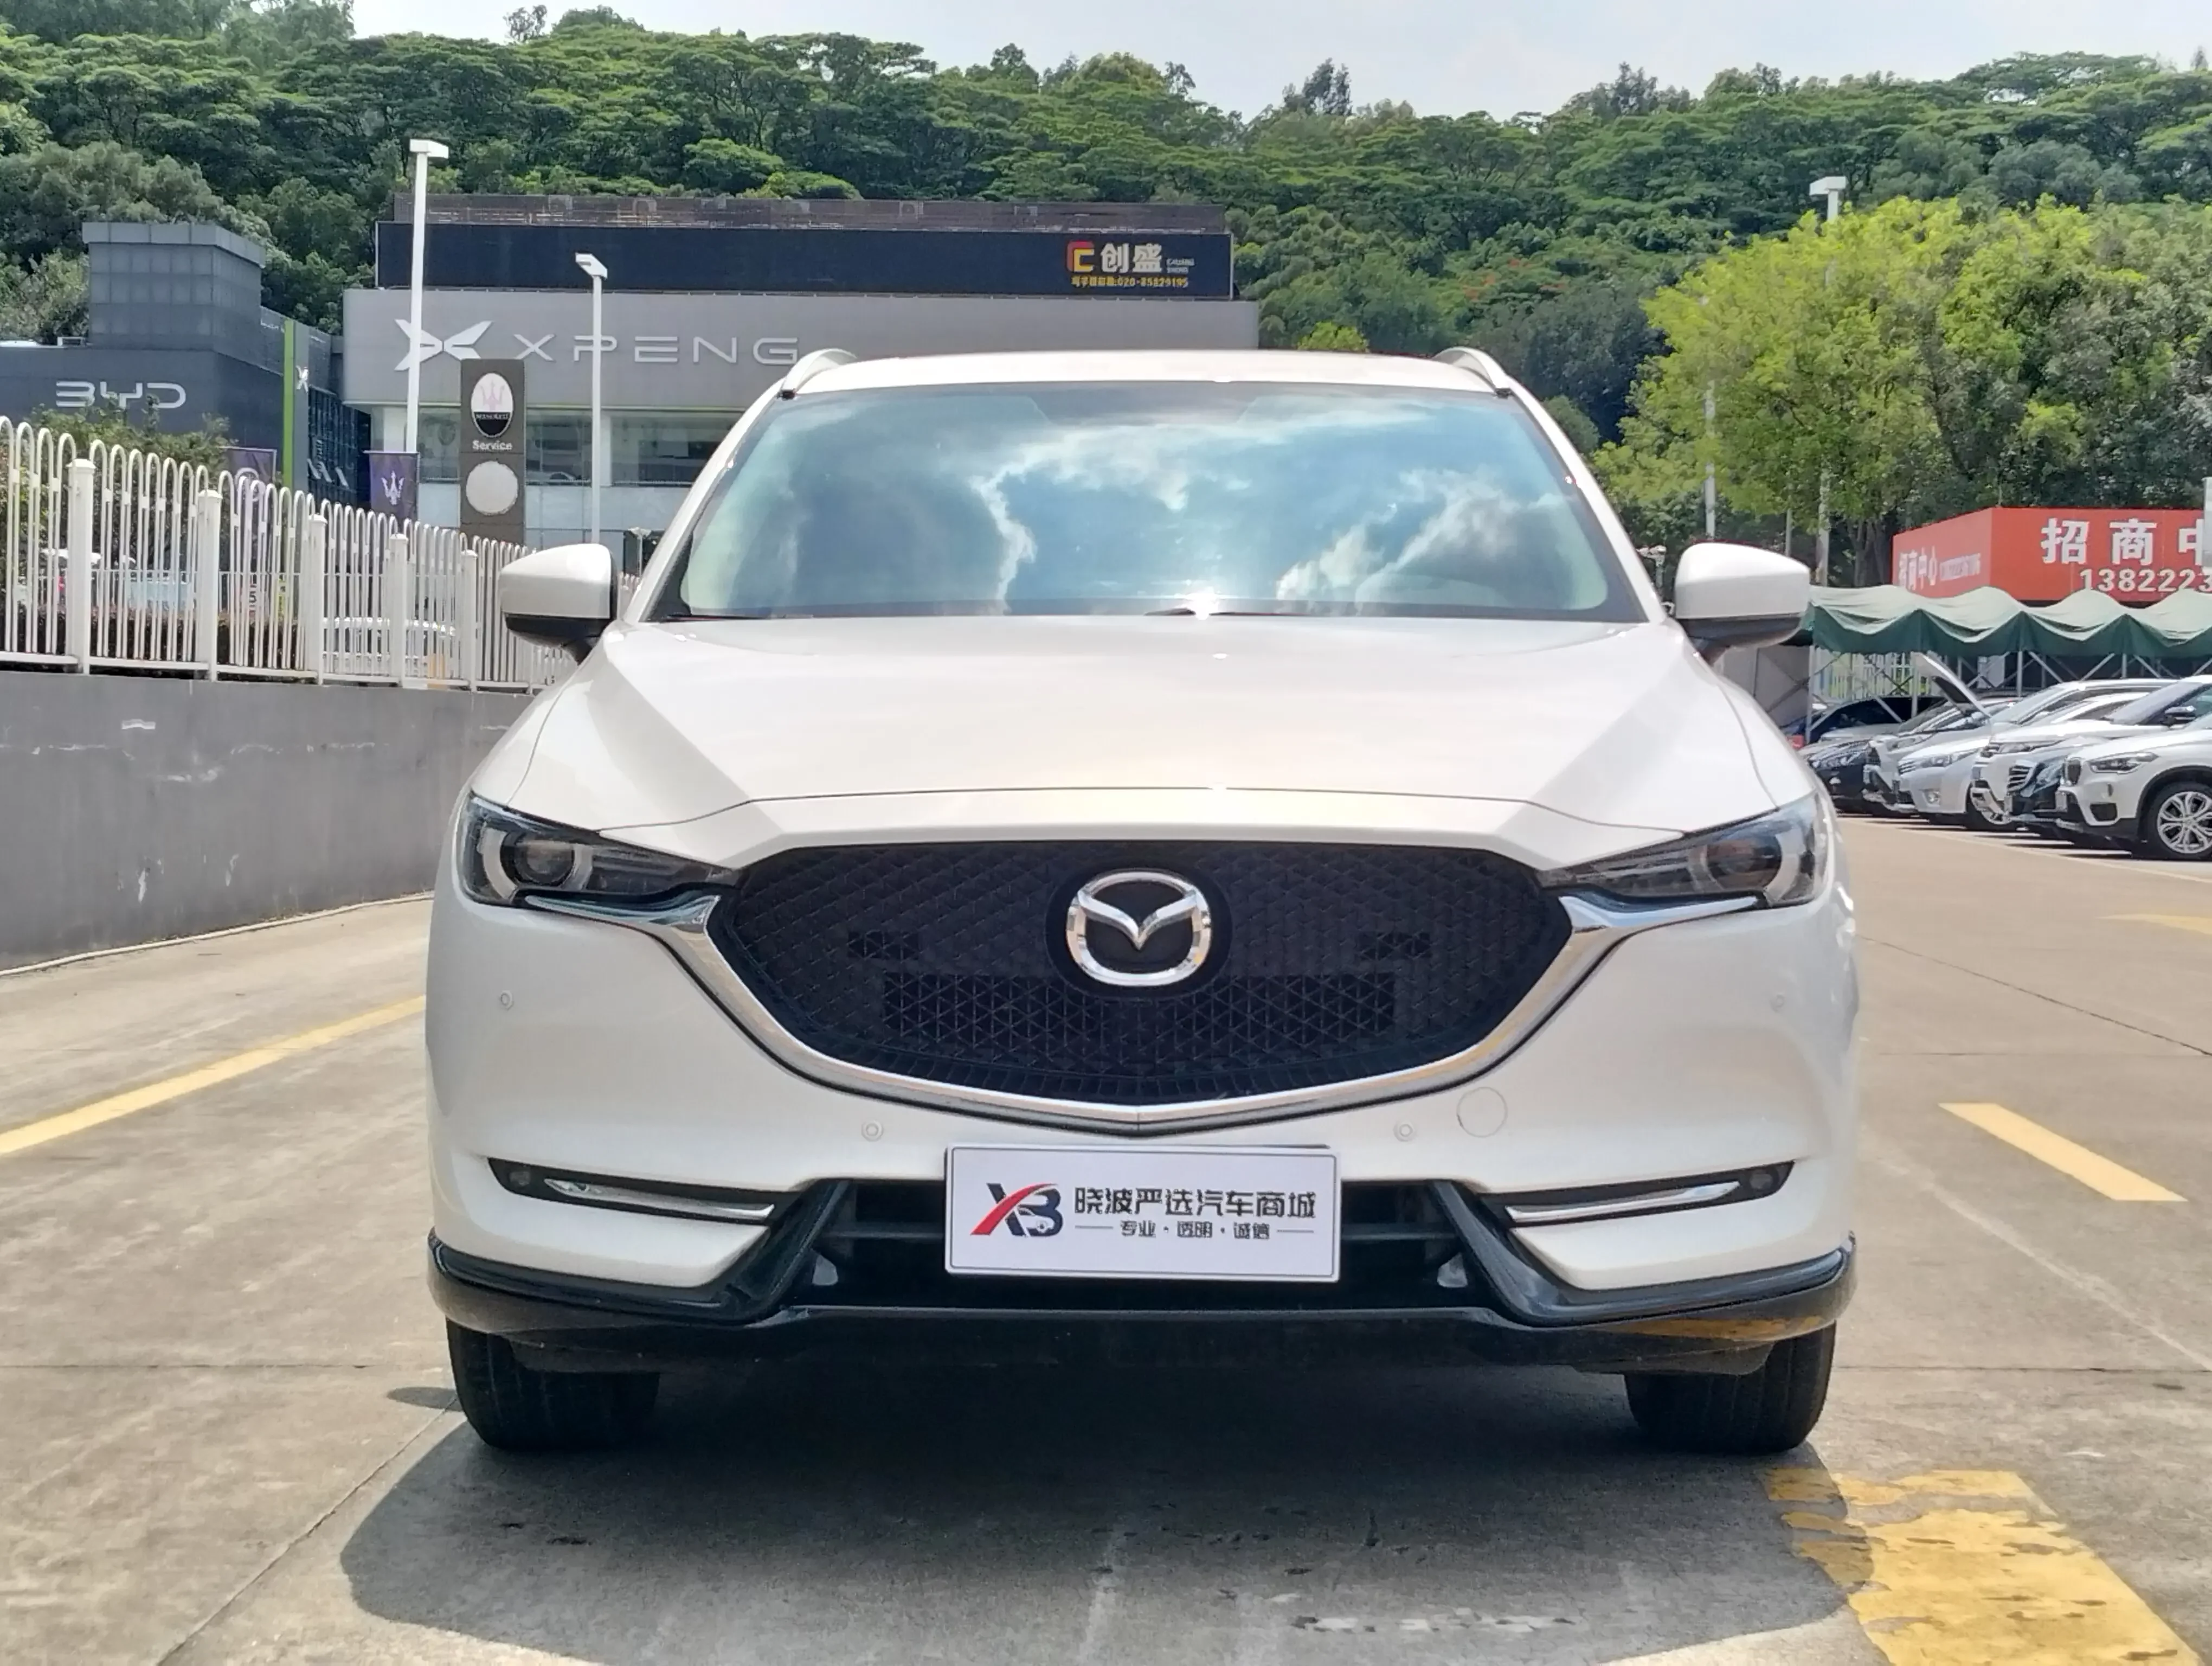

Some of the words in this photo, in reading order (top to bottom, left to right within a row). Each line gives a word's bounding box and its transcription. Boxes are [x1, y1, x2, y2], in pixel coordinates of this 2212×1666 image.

[1101, 242, 1162, 273] 创盛
[513, 333, 798, 365] XPENG
[55, 380, 187, 409] BYD
[472, 439, 513, 451] Service
[1073, 1186, 1317, 1219] 晓波严选汽车商城
